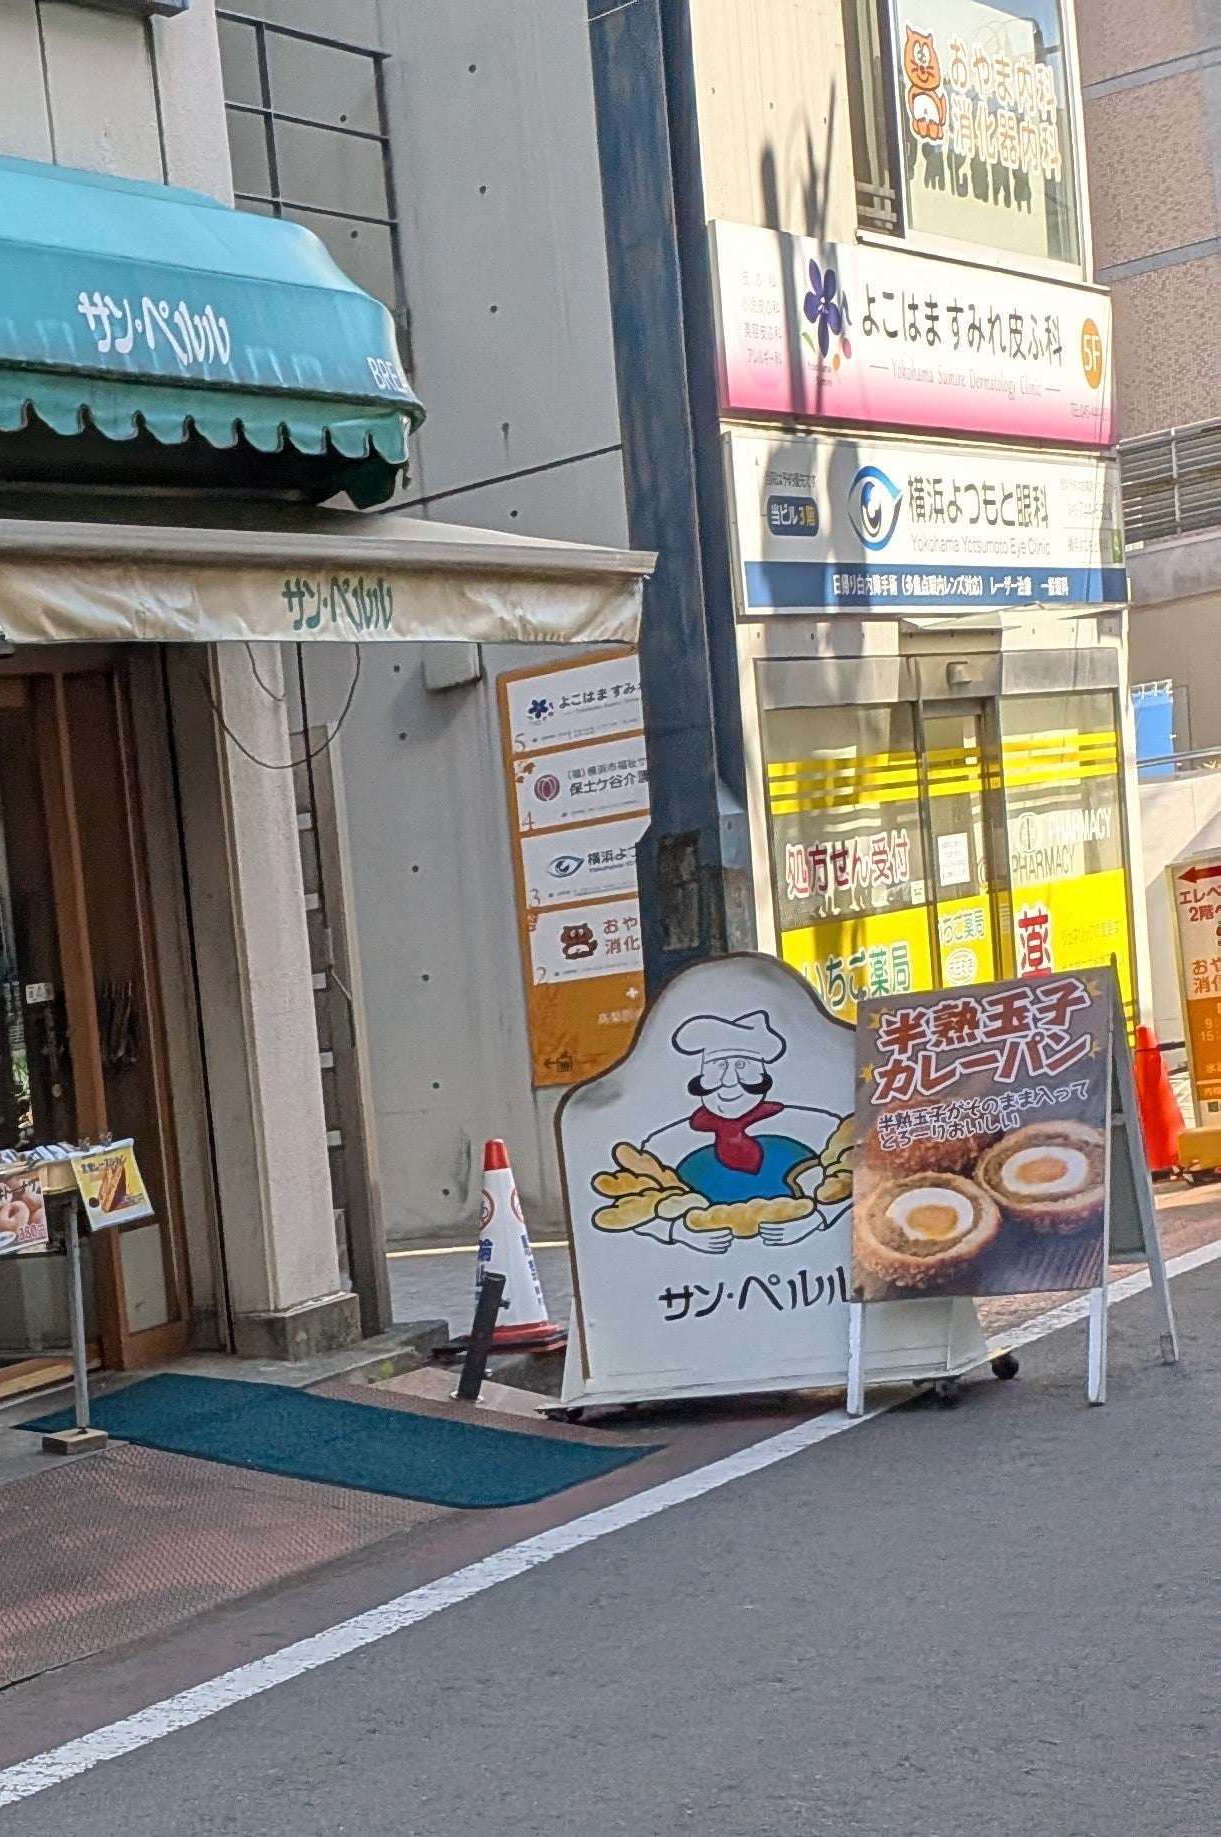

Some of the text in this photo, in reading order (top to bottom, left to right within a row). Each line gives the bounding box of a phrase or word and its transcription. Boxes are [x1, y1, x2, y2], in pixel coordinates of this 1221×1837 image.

[948, 33, 1057, 124] おやま内科
[951, 93, 1062, 183] 消化器内科
[1083, 333, 1101, 373] 5F
[908, 475, 1049, 528] 横浜よつもと眼科
[911, 534, 960, 553] Yokohama
[961, 536, 1009, 555] Yotsumoto
[1010, 538, 1026, 559] Eye
[1028, 538, 1051, 556] Clinic
[559, 682, 642, 709] よこはますみ
[521, 811, 536, 830] 4
[1049, 807, 1112, 843] PHARMACY
[786, 829, 910, 900] 処方せん受付
[603, 916, 638, 935] おや
[605, 934, 641, 955] 消化
[878, 977, 1091, 1057] 半熟玉子
[871, 1030, 1091, 1104] カレーパン
[878, 1080, 1090, 1132] 半熟玉子がそのまま入って
[880, 1112, 1020, 1151] とろーりおいしい
